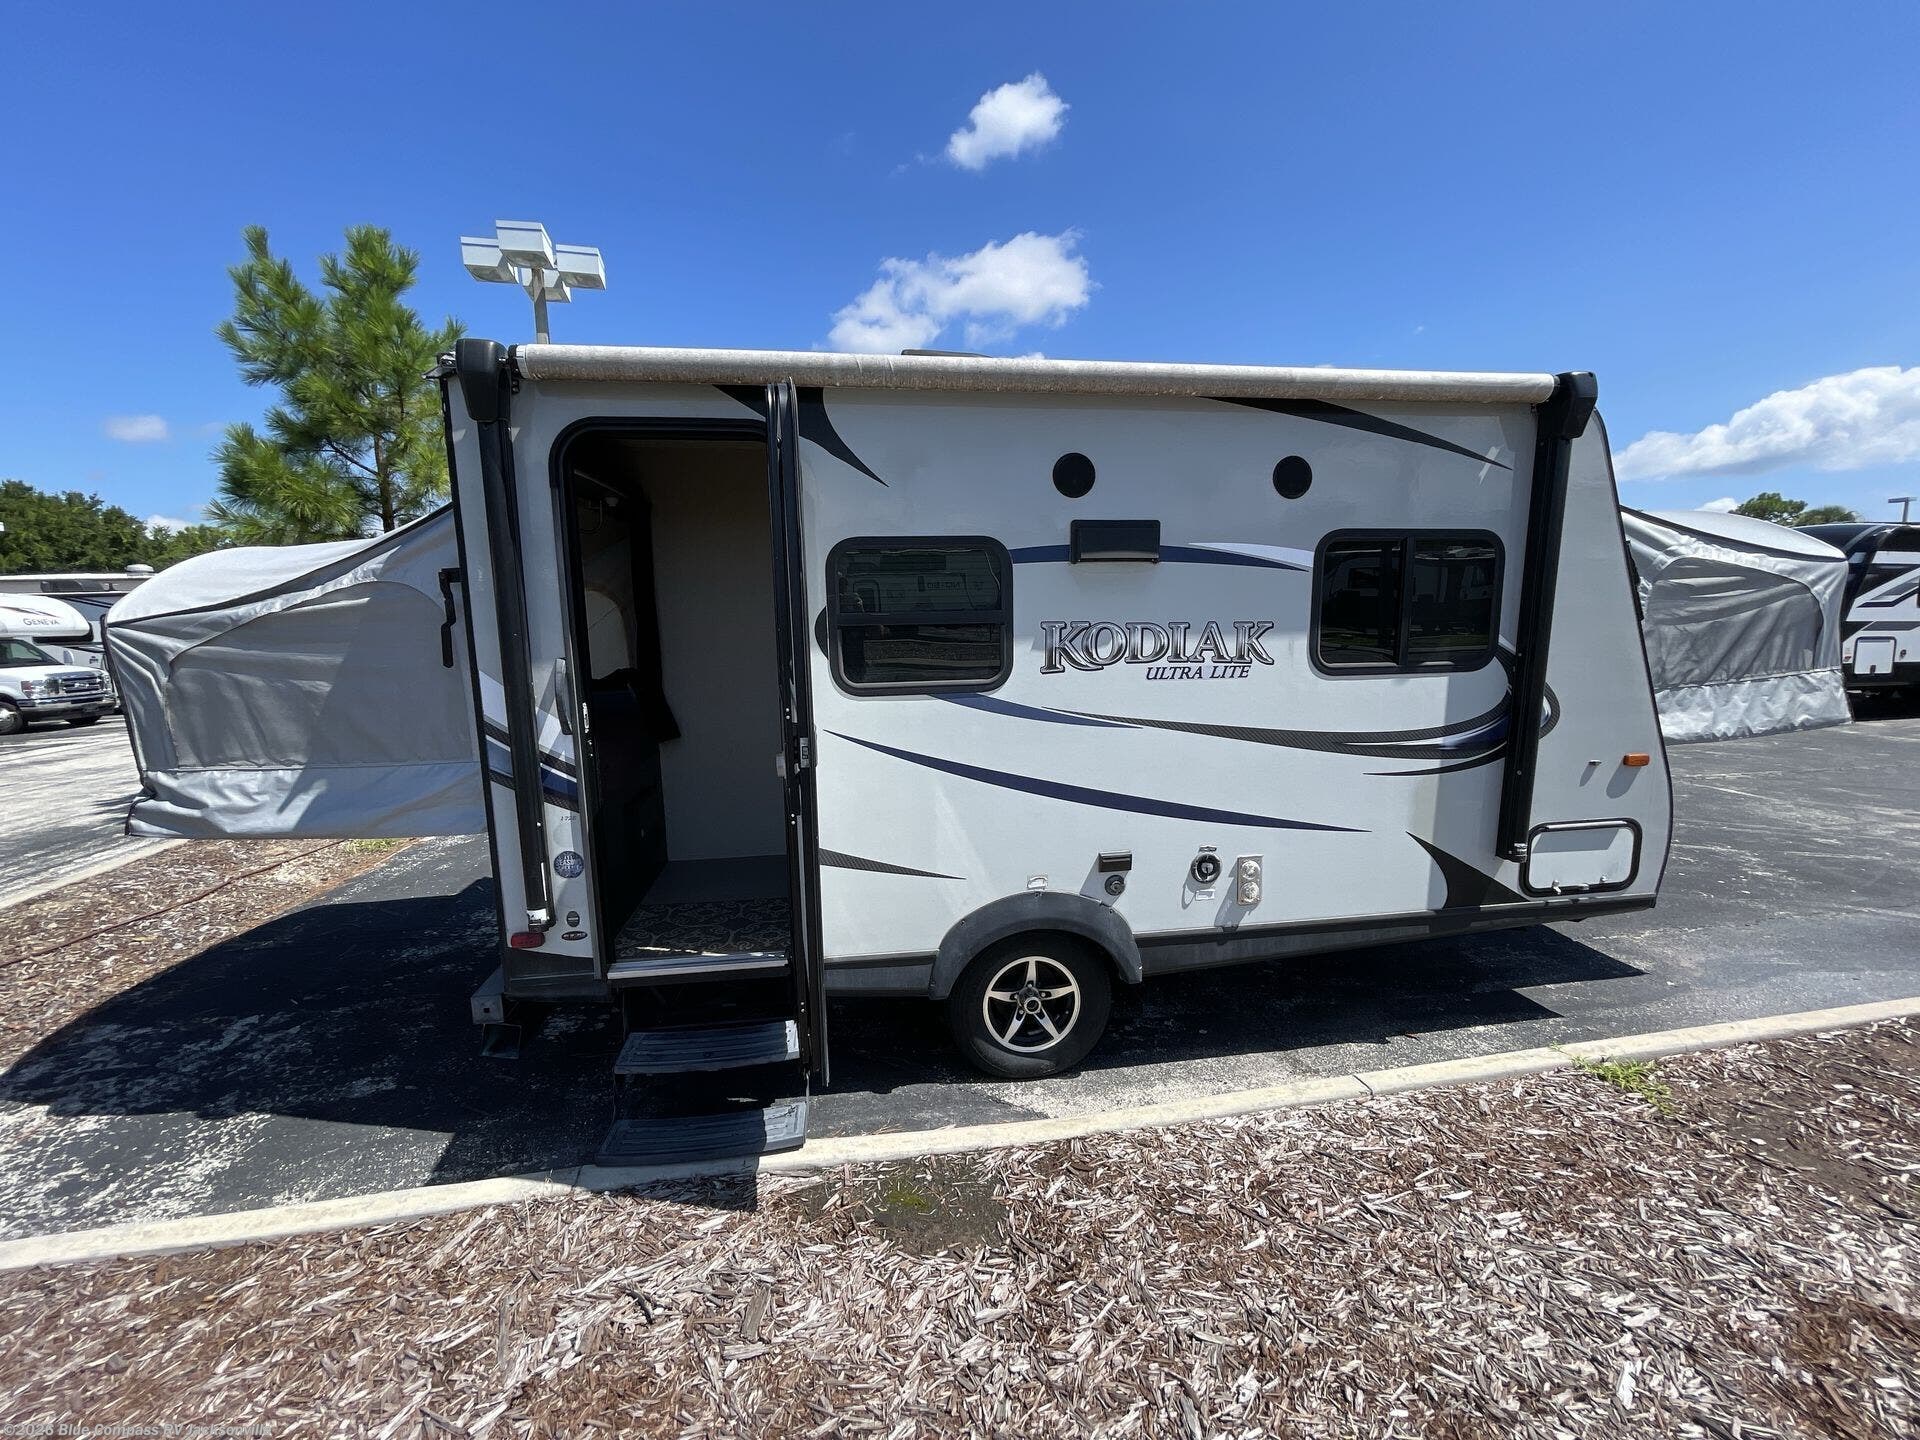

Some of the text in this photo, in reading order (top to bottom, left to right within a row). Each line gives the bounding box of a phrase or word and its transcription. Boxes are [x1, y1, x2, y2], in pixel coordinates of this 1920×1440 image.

[1040, 621, 1274, 674] KODIAK
[1146, 665, 1250, 681] ULTRA LITE
